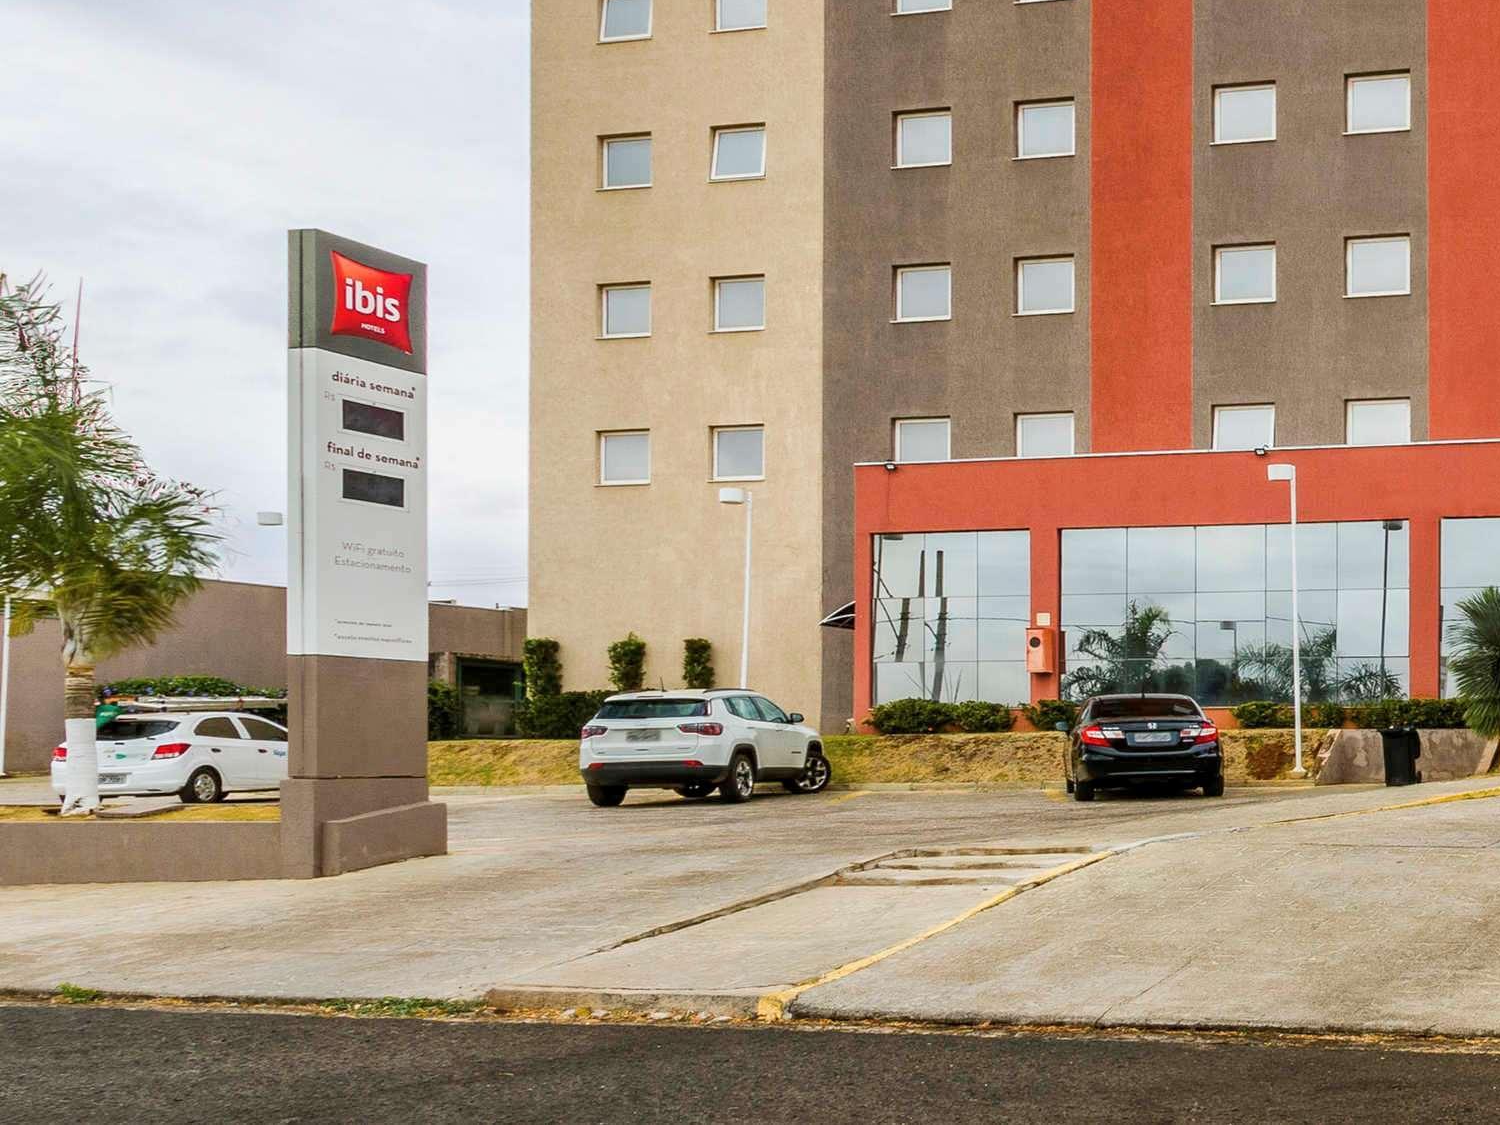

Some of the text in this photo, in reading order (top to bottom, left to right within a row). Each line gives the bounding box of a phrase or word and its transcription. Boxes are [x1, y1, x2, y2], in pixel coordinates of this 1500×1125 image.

[345, 277, 401, 322] ibis
[331, 371, 367, 388] diária
[327, 441, 354, 457] final
[356, 448, 372, 460] de
